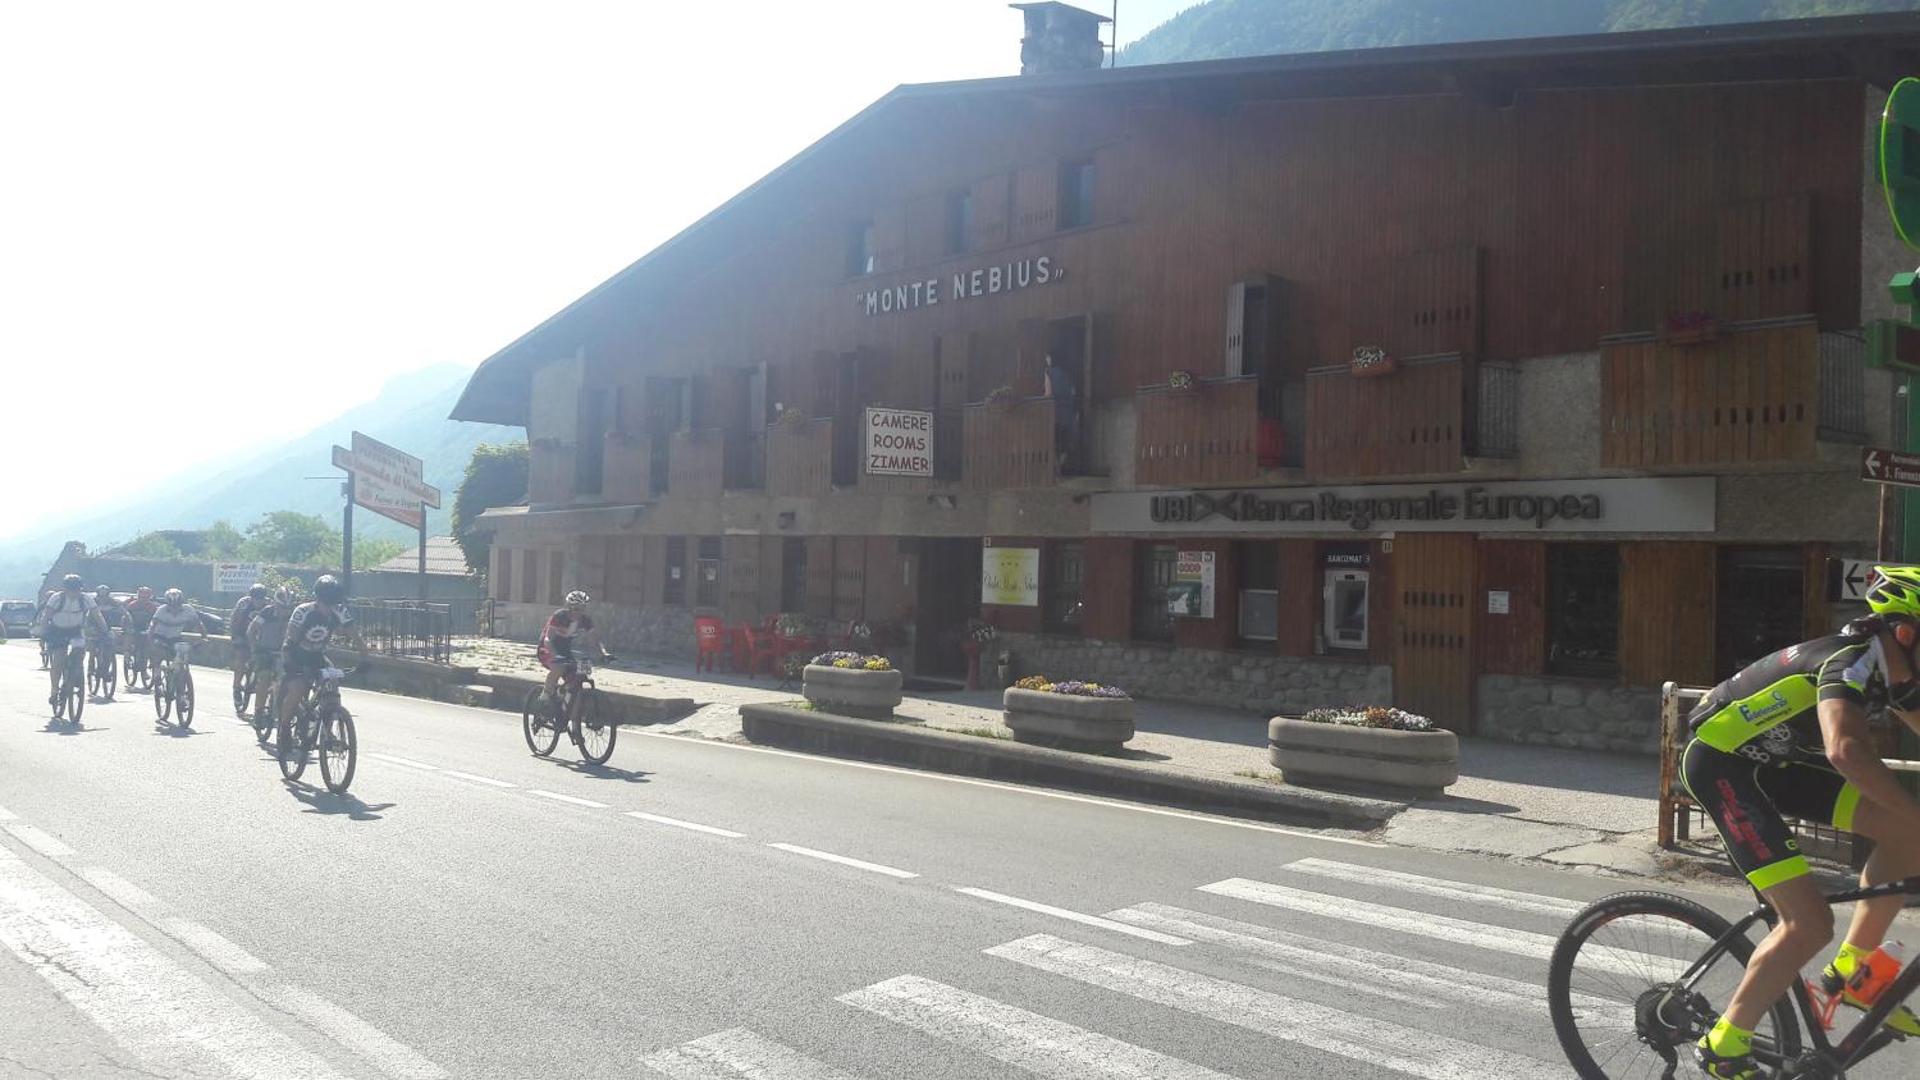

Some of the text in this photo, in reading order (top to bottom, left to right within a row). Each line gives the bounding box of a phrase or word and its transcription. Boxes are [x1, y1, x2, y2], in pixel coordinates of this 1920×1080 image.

[871, 414, 928, 431] CAMERE
[873, 434, 926, 451] ROOMS
[870, 454, 929, 471] ZIMMER
[1150, 486, 1601, 531] UBI Banca Regionale Europea
